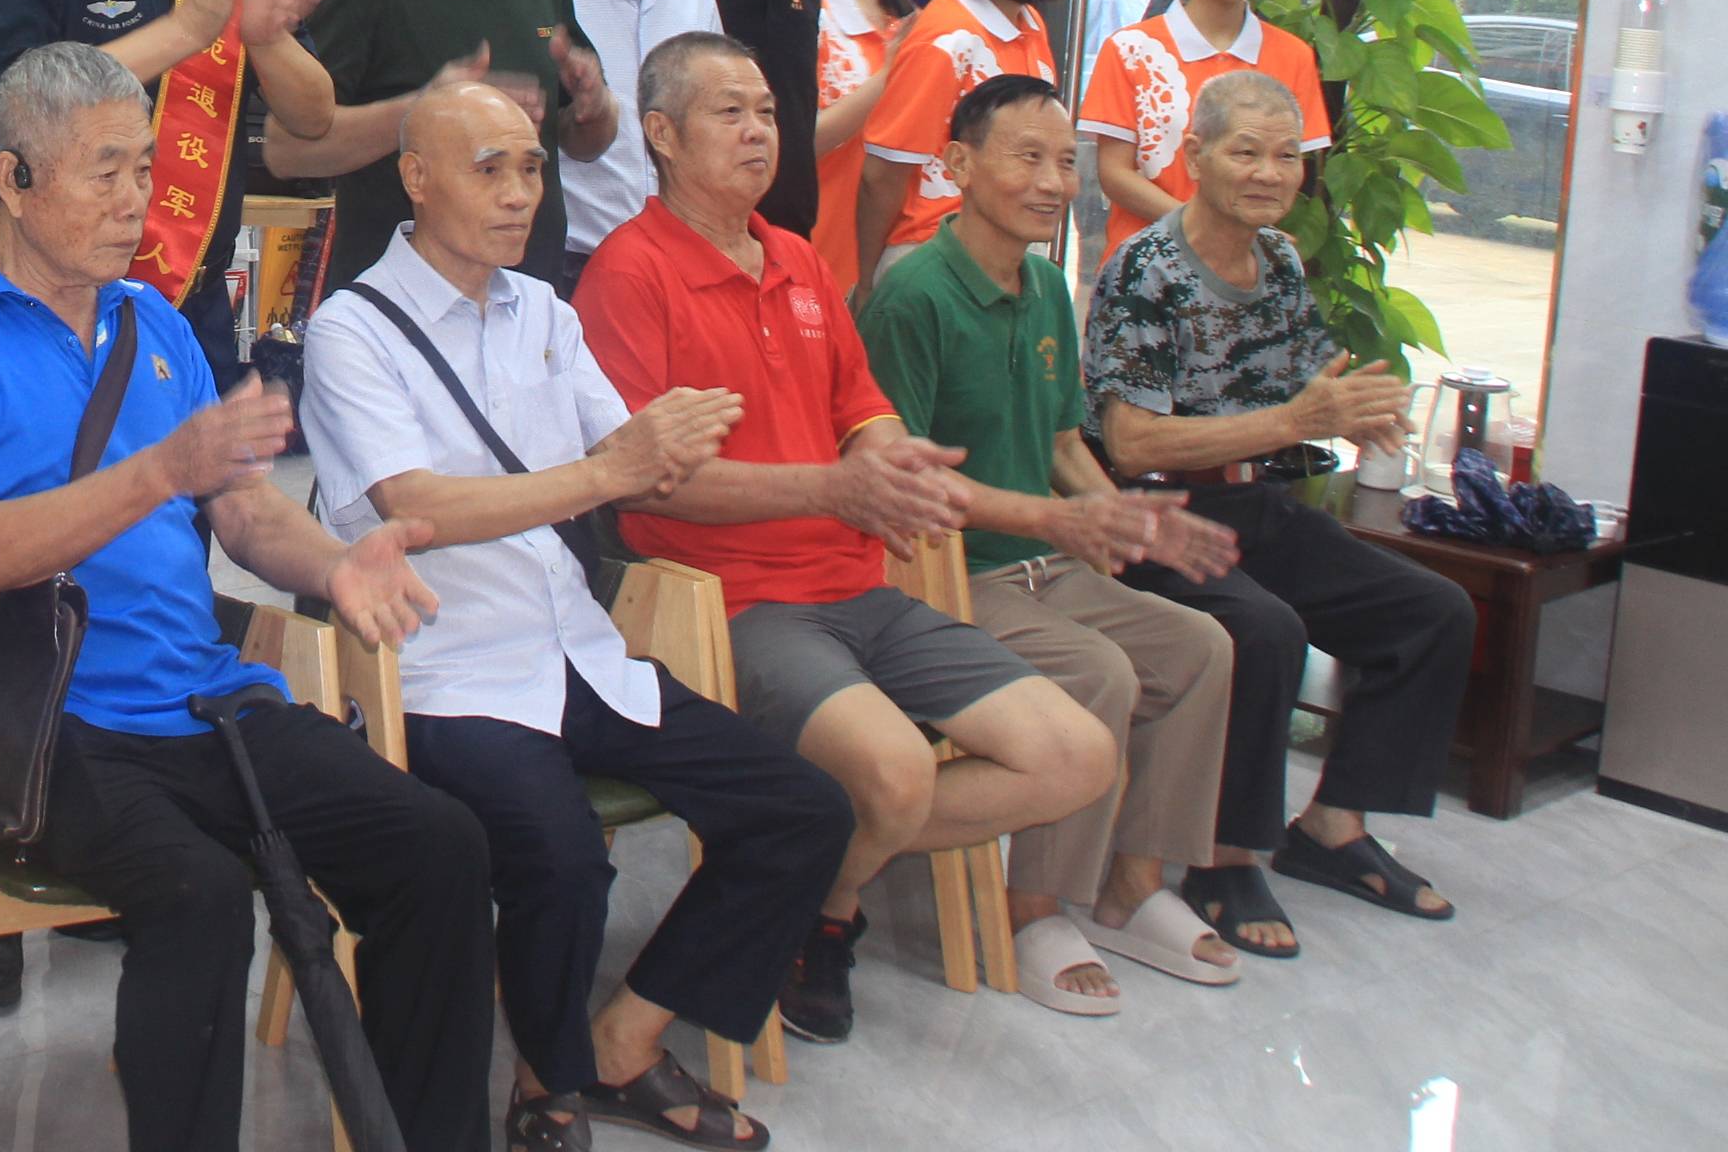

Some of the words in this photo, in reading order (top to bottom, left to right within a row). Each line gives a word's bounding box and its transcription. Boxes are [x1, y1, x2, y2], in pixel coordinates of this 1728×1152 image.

[81, 16, 106, 30] CHINA
[108, 22, 121, 30] AIR
[121, 11, 144, 28] FORCE
